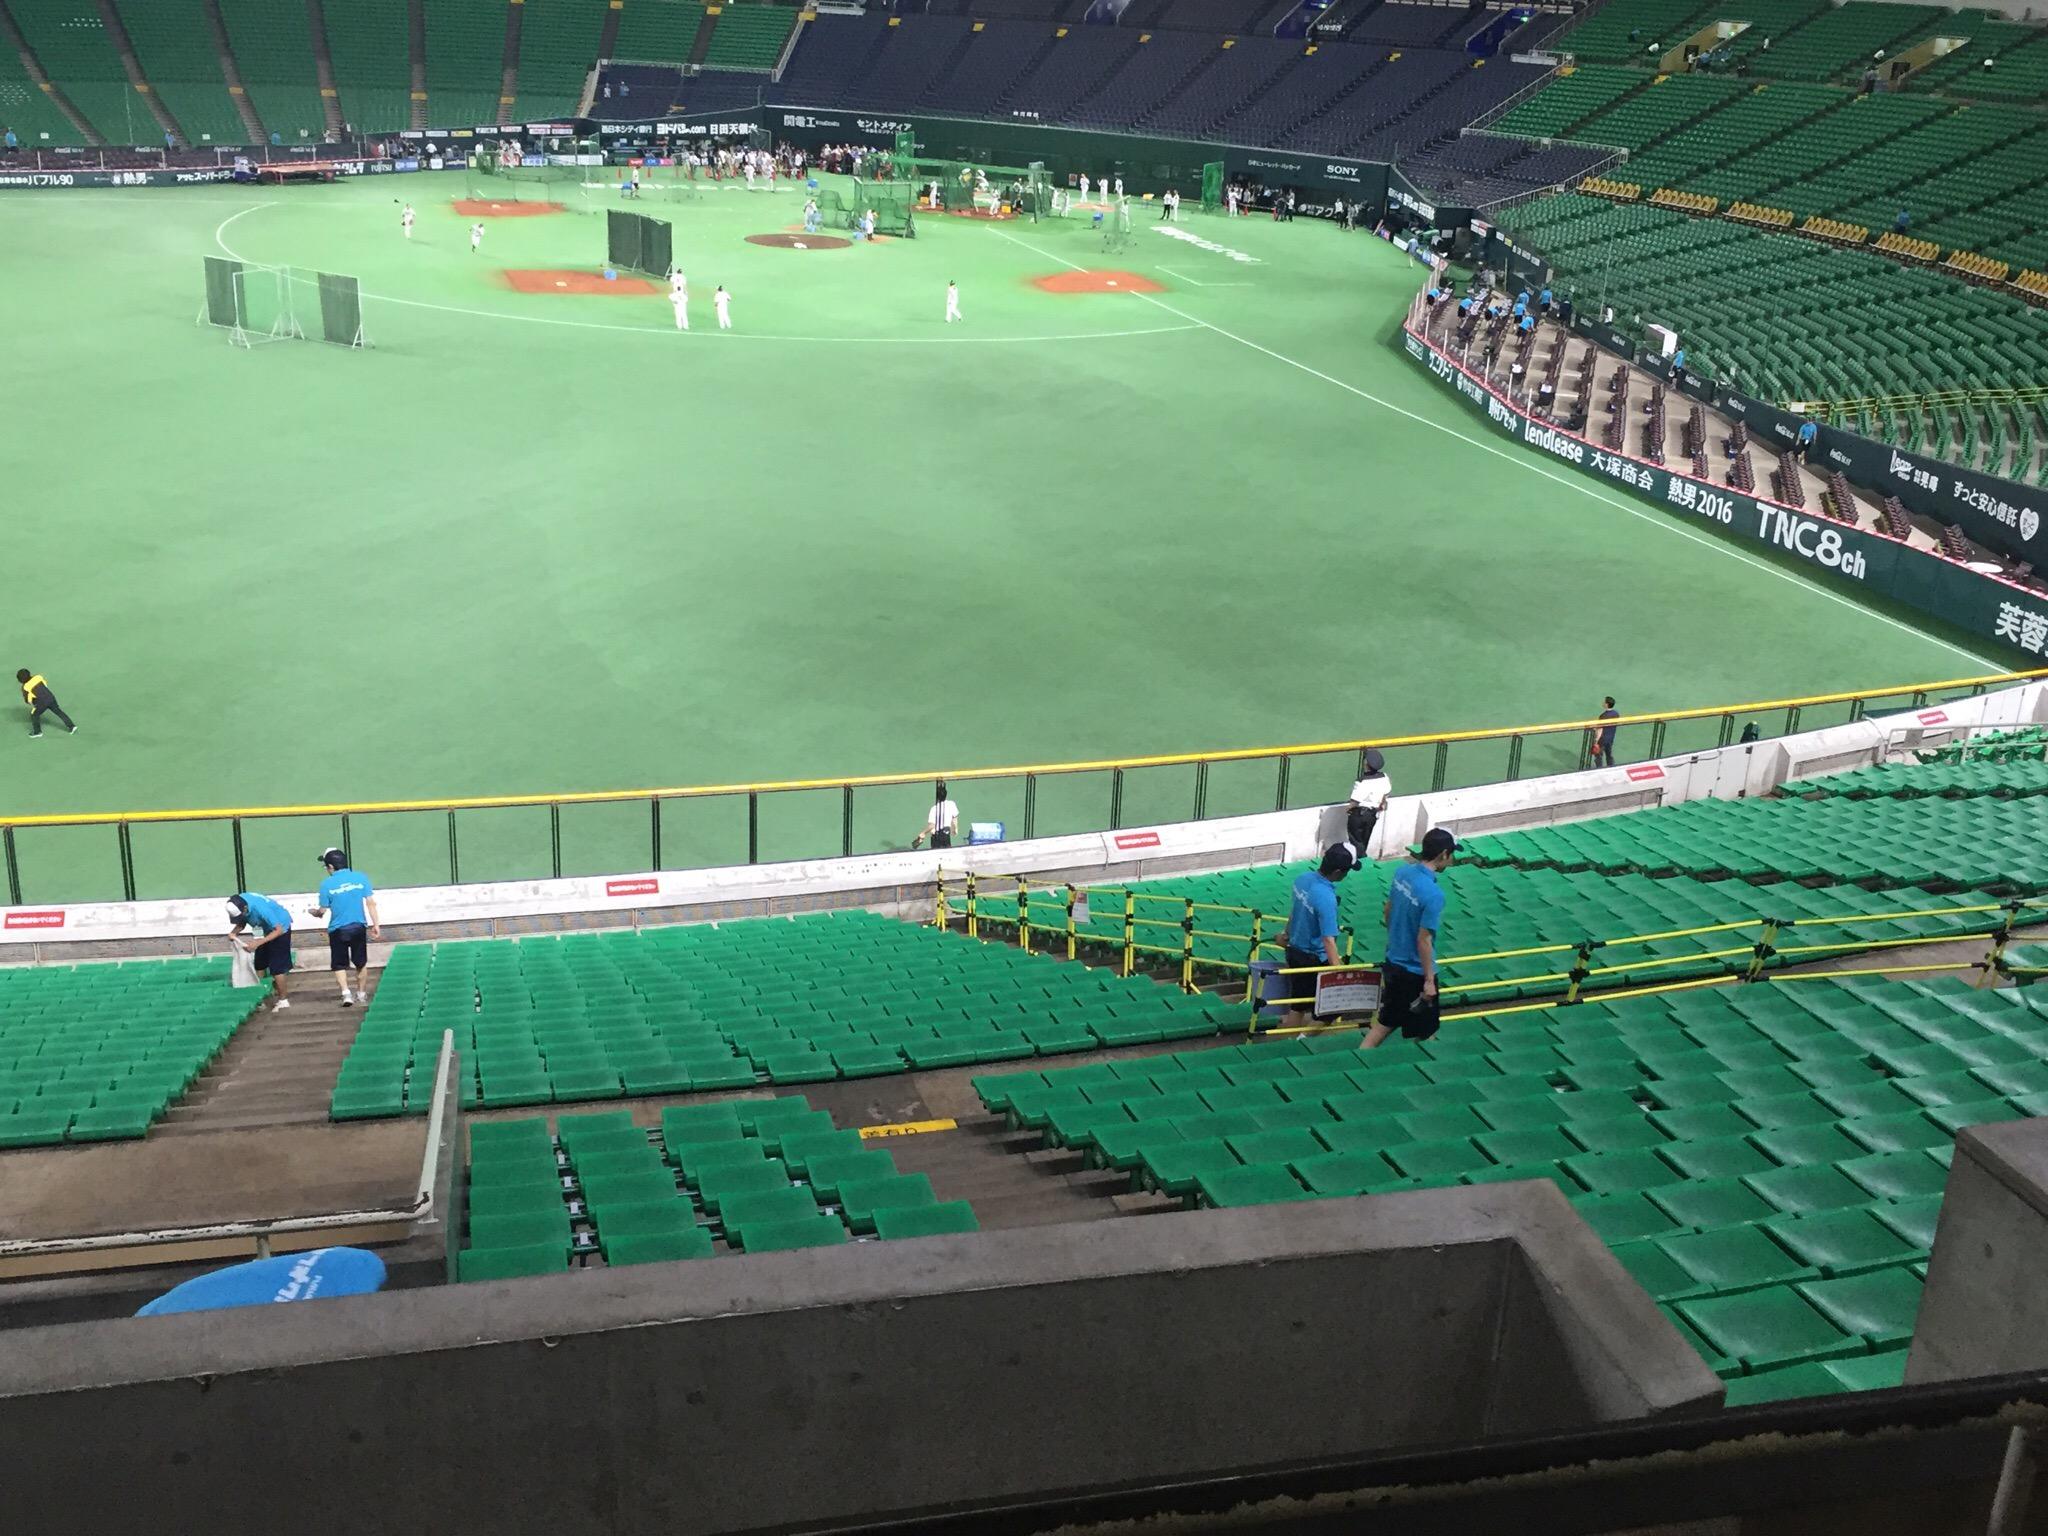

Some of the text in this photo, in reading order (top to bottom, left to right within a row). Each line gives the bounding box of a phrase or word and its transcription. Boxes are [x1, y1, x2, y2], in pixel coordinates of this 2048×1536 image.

[1326, 164, 1359, 176] SONY
[1590, 452, 1654, 491] 大塚商会
[1953, 481, 2019, 528] ずっと安心信託
[1756, 502, 1866, 580] TNC8ch
[1995, 601, 2048, 658] 芙蓉
